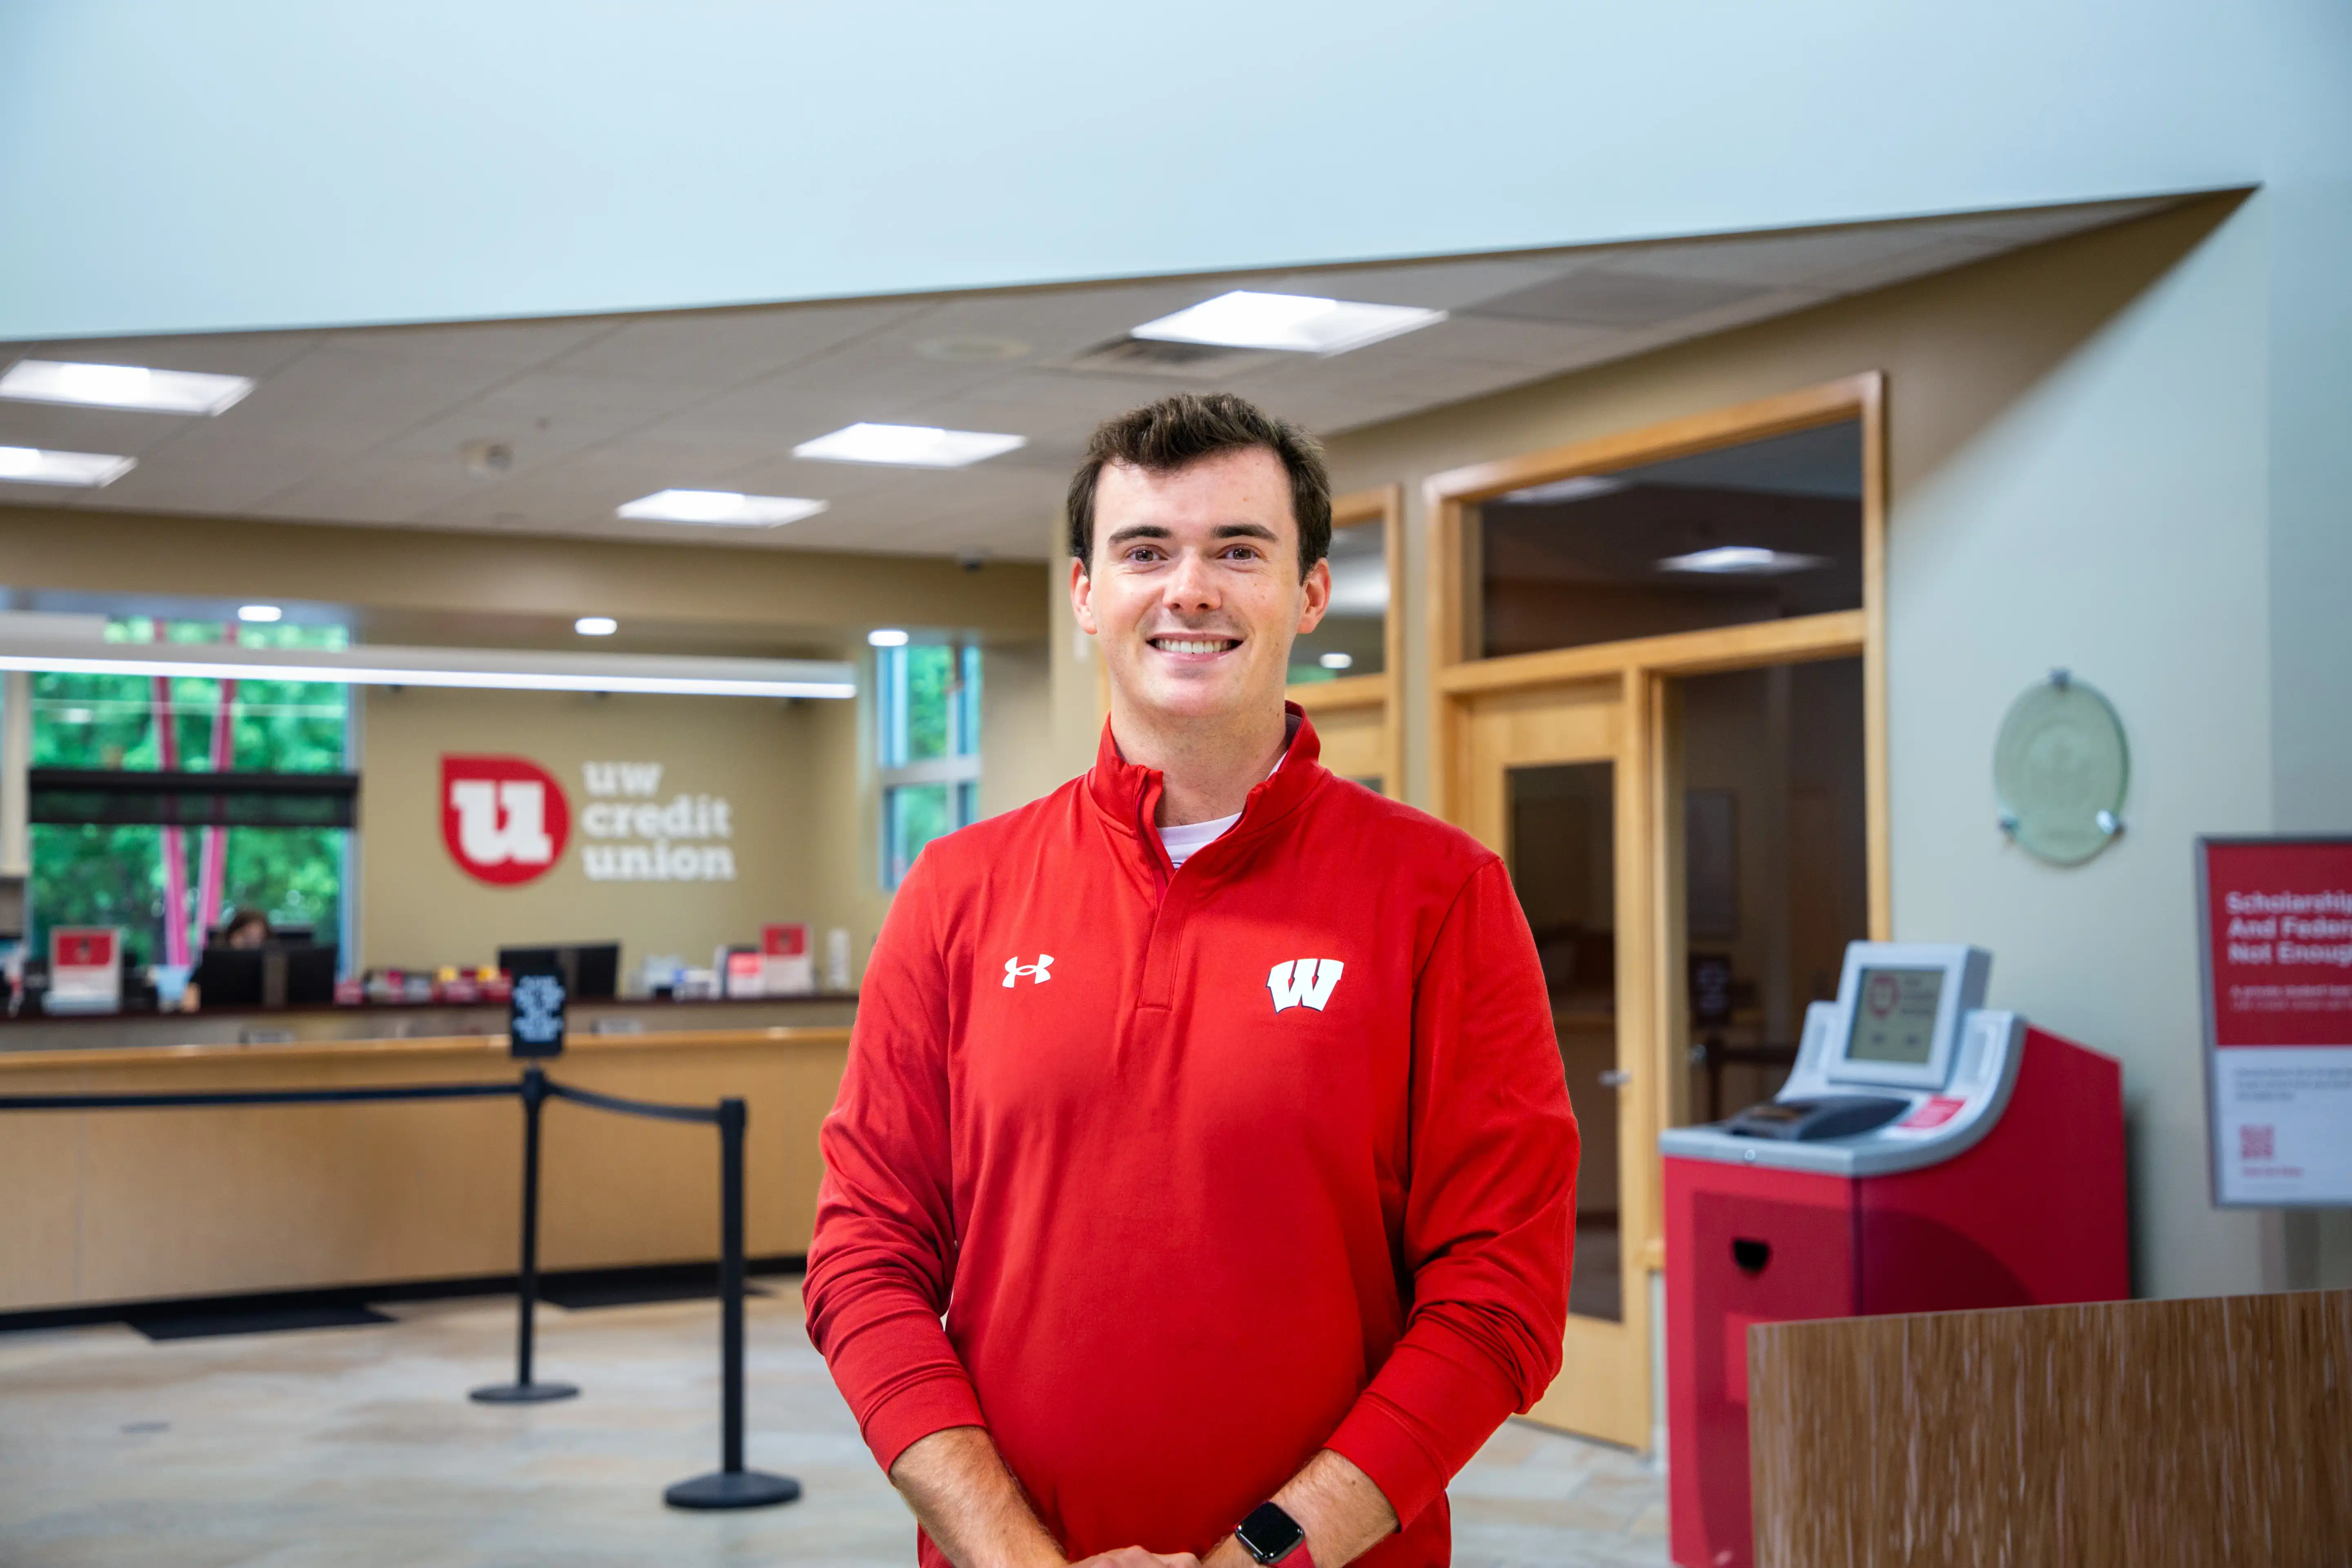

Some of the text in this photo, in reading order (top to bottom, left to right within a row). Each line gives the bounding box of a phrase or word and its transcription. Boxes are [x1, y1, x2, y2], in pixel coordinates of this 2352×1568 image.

[583, 762, 662, 794] uw
[452, 781, 552, 865] u
[582, 795, 731, 837] credit
[583, 839, 734, 880] union
[2228, 916, 2276, 939] And
[2228, 942, 2272, 964] Not
[1265, 958, 1344, 1014] W
